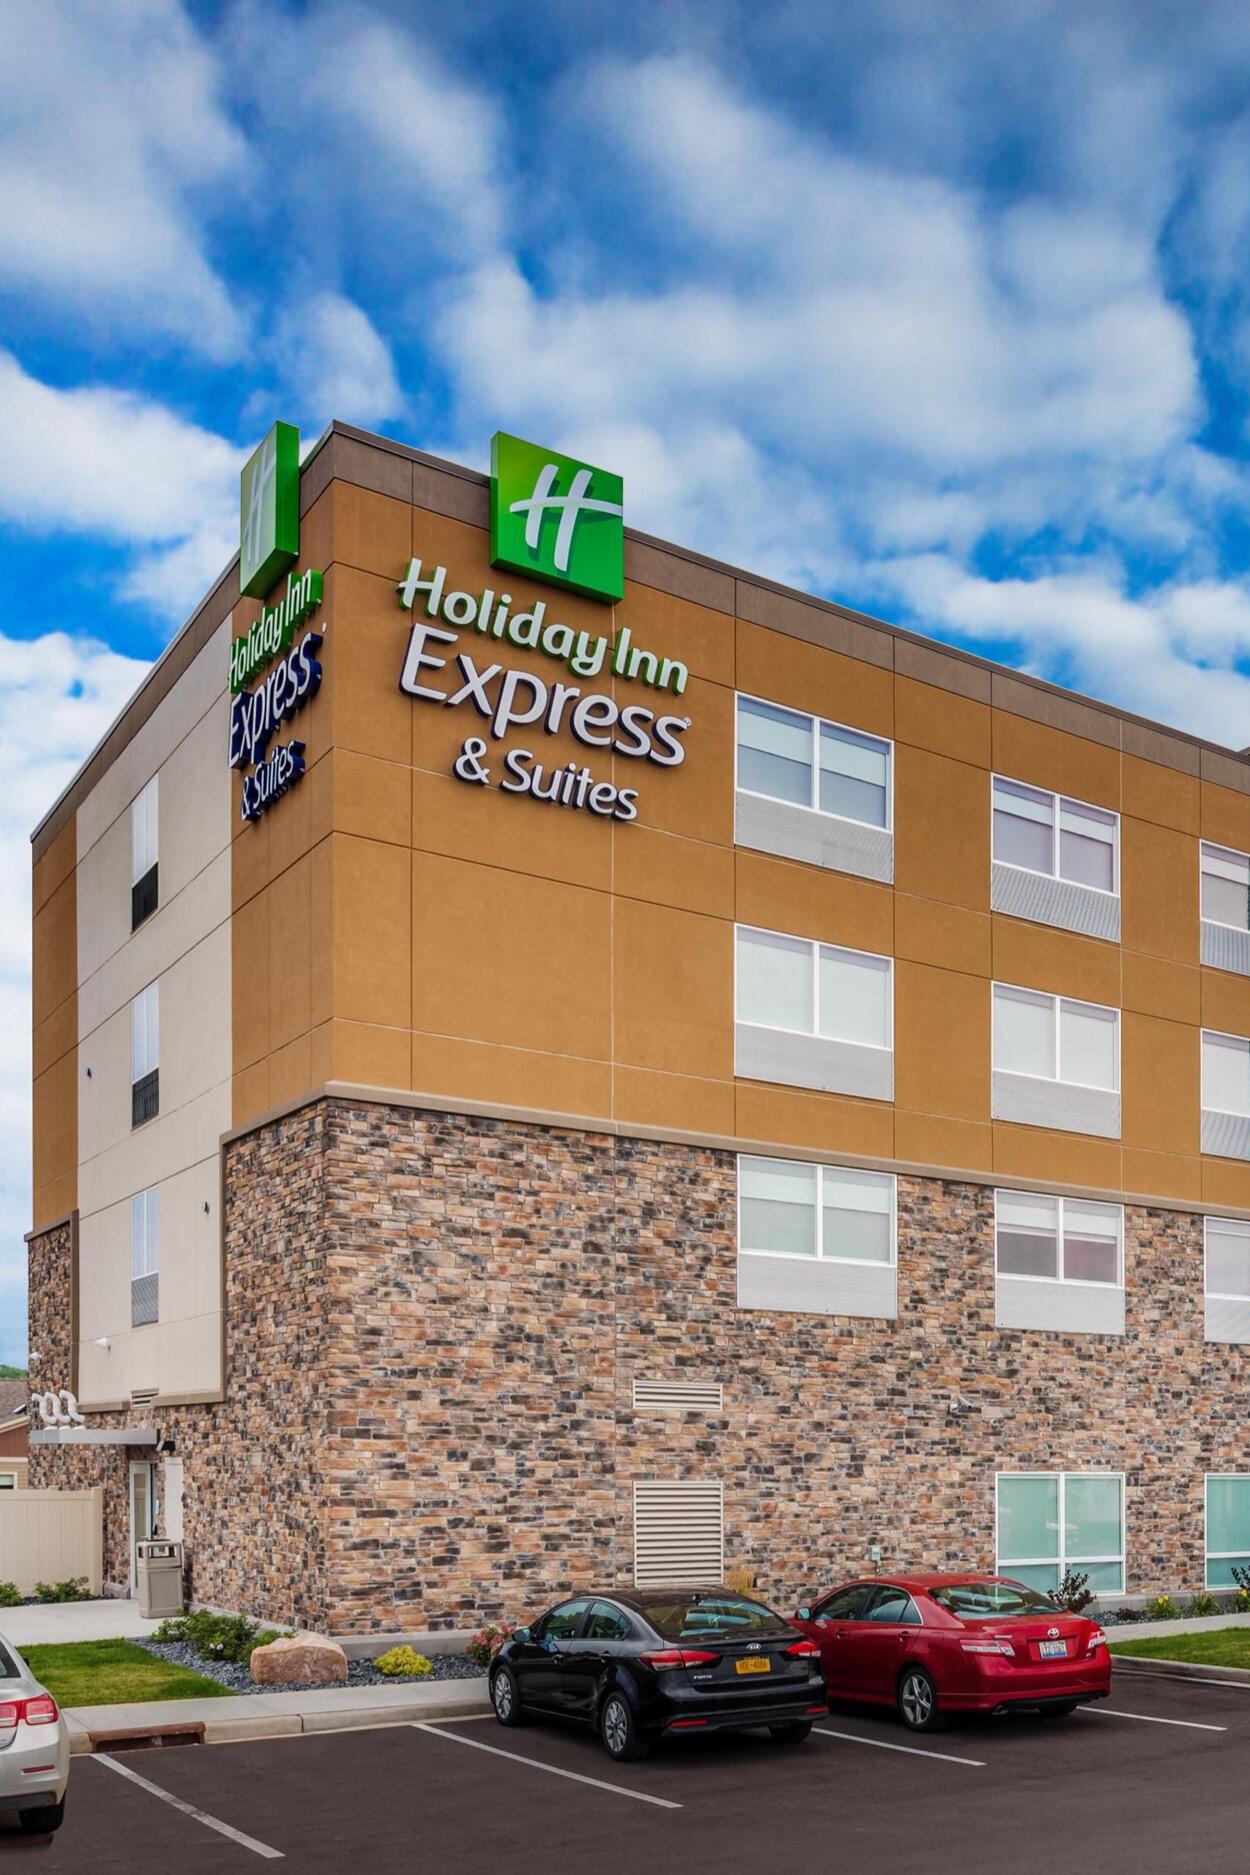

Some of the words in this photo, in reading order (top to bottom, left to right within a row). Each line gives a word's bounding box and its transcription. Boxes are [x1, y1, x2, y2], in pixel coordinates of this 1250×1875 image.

[229, 600, 284, 696] Holiday
[285, 568, 313, 627] Inn
[398, 557, 608, 677] Holiday
[614, 626, 689, 694] Inn
[229, 631, 312, 768] Express
[400, 622, 687, 766] Express
[253, 740, 295, 809] Suites
[454, 737, 490, 784] &
[502, 748, 639, 820] Suites
